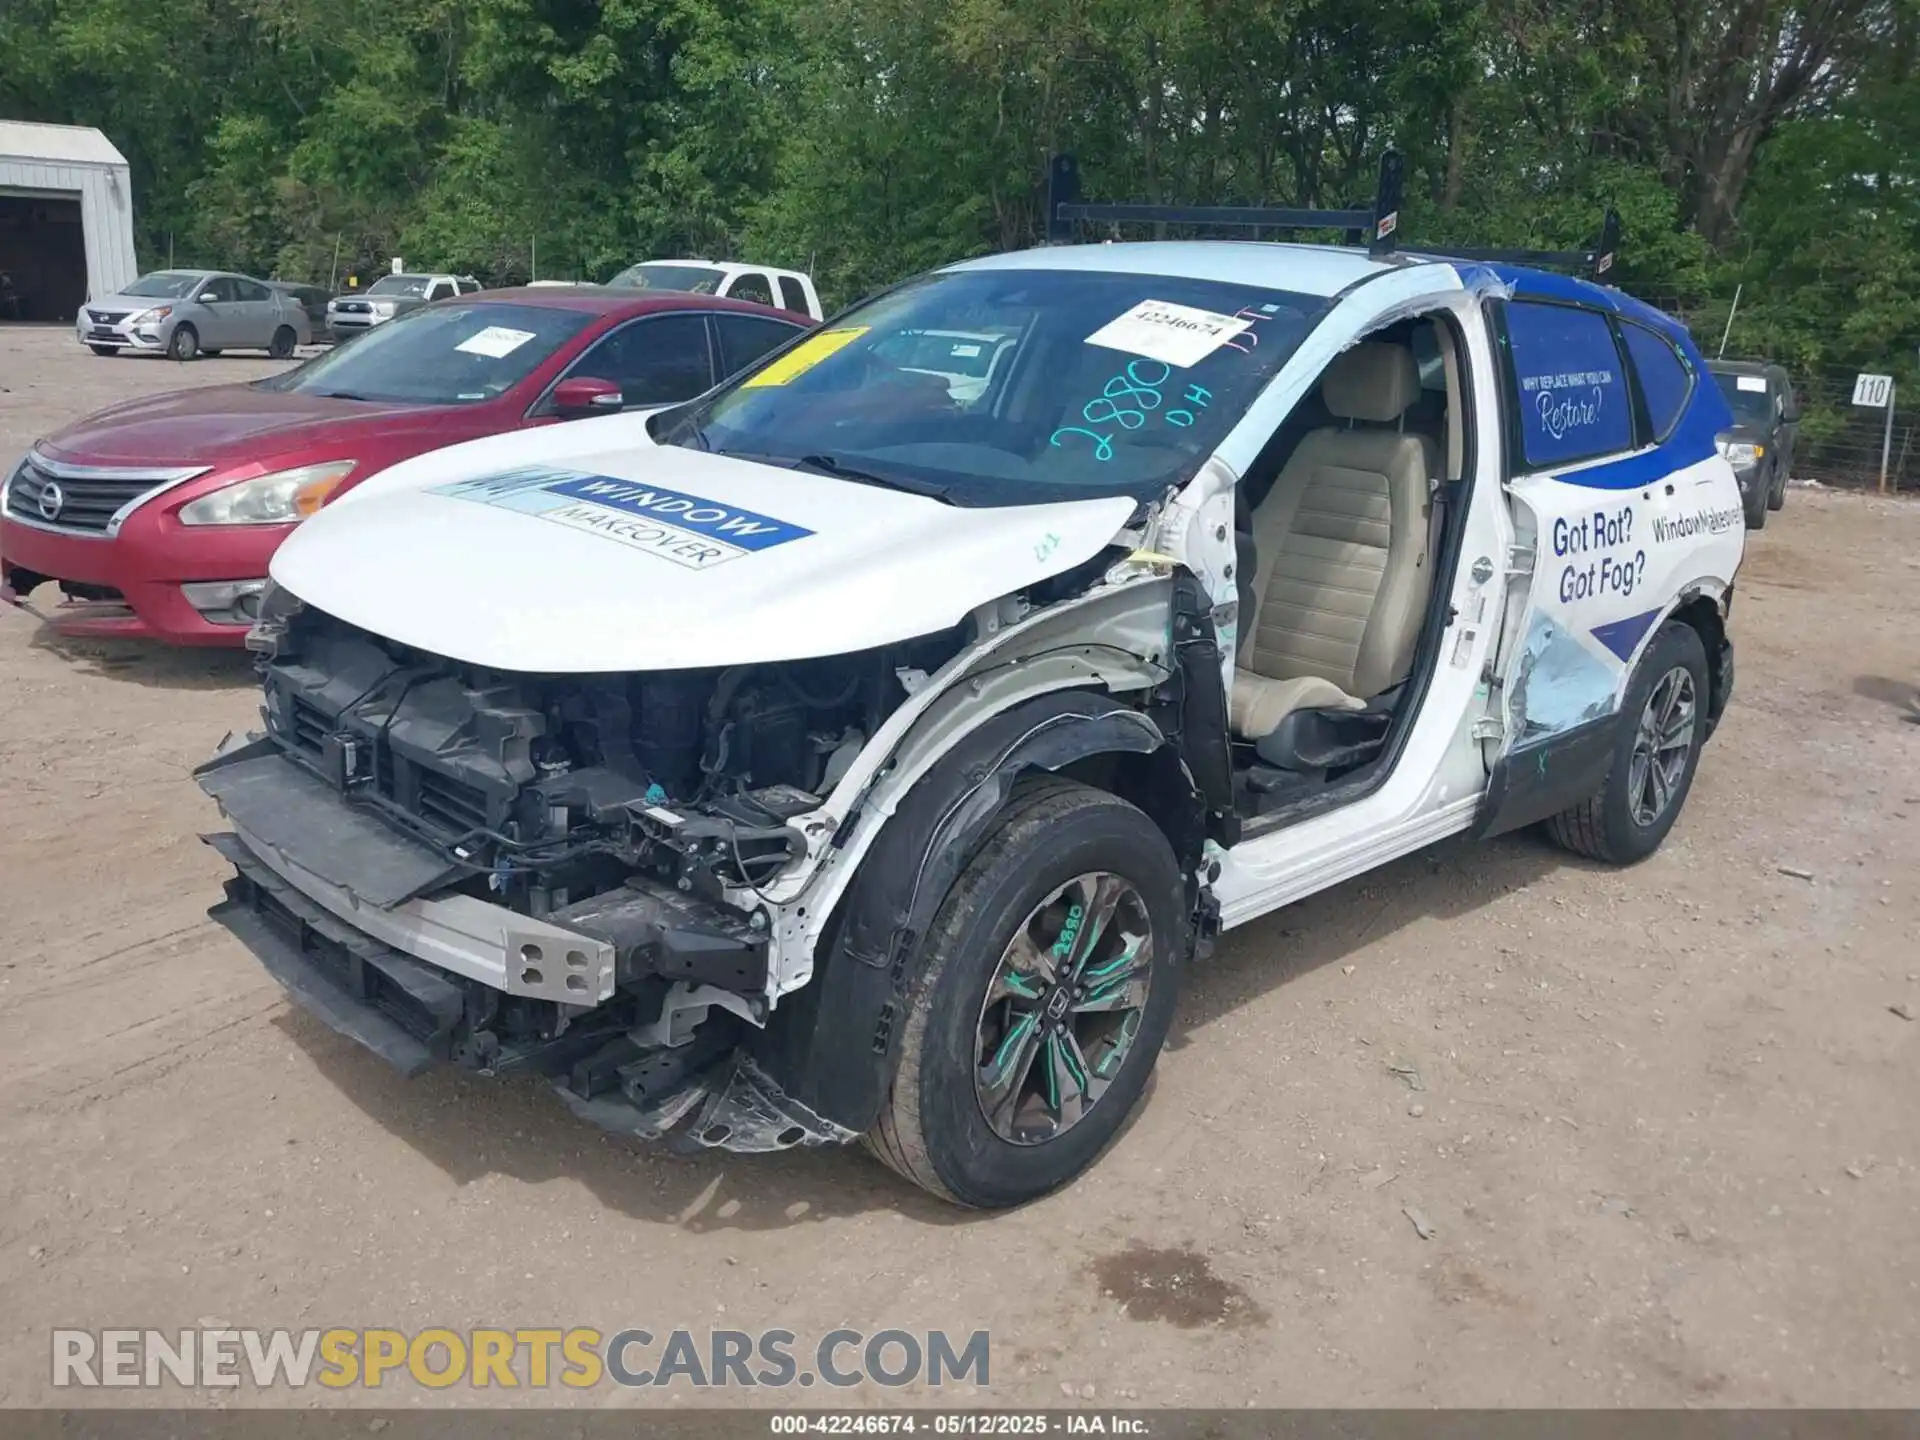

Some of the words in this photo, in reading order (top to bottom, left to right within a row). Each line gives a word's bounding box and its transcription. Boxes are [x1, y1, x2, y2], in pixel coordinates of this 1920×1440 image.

[1135, 310, 1224, 337] 42246674
[1050, 358, 1170, 461] 2880
[1535, 386, 1602, 440] Restore?
[1858, 378, 1886, 403] 110
[559, 506, 722, 563] MAKEOVER
[579, 480, 779, 537] WINDOW
[1553, 516, 1588, 557] Got
[1594, 506, 1633, 549] Rot?
[1560, 563, 1595, 603] Got
[1600, 549, 1645, 596] Fog?
